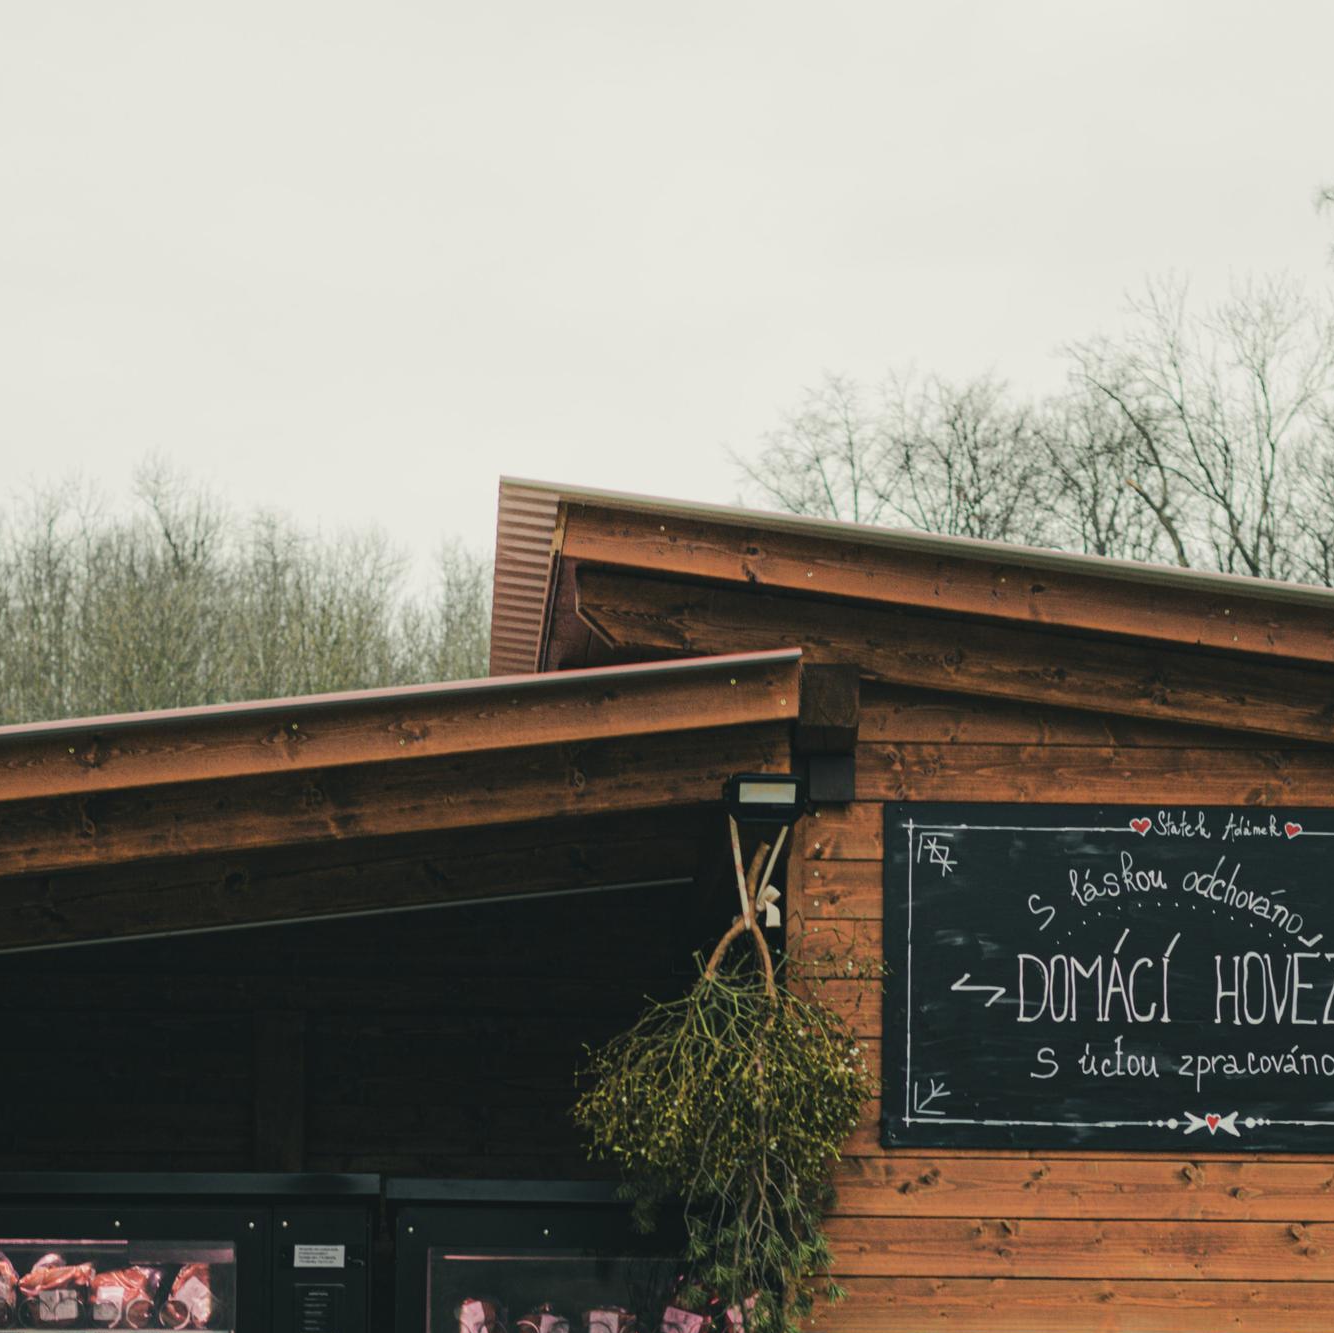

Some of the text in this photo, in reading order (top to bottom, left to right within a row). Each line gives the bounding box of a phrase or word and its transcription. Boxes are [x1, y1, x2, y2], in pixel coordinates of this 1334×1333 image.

[1153, 810, 1282, 842] Statek Adámek
[1069, 851, 1167, 906] láskou
[1182, 855, 1304, 934] odchováno
[1017, 928, 1181, 1023] DOMÁCÍ
[1078, 1035, 1160, 1078] úctou
